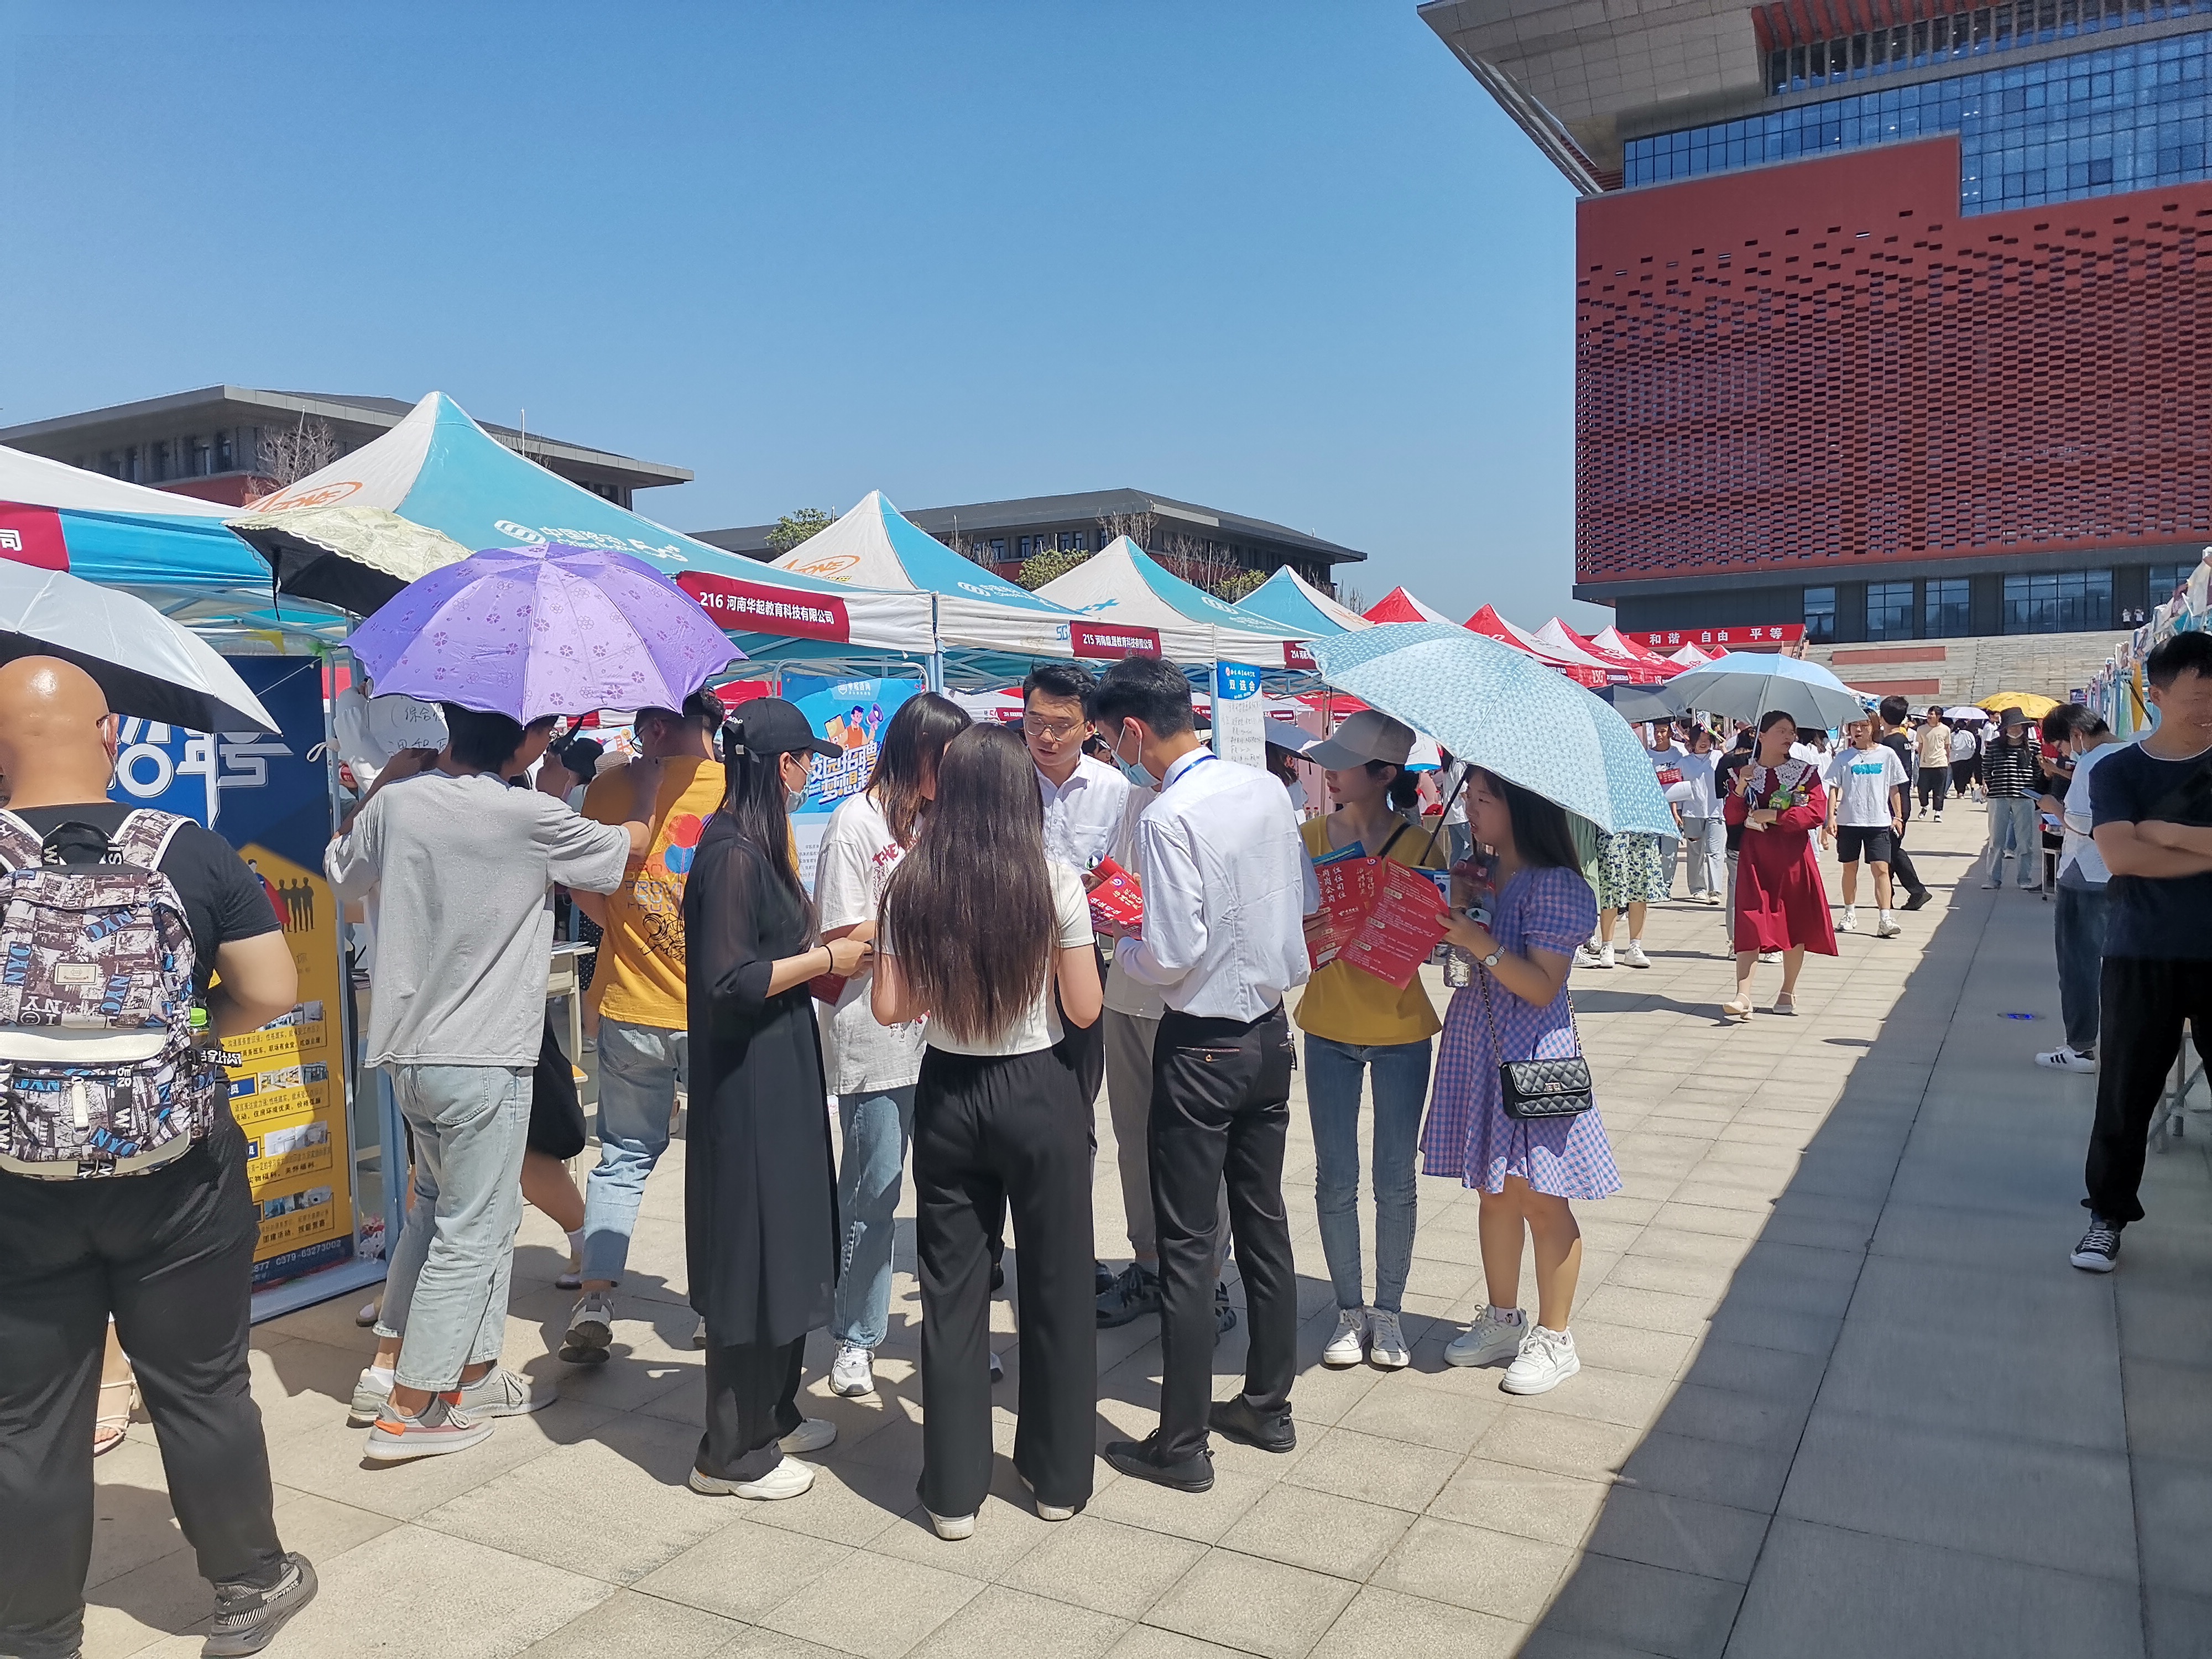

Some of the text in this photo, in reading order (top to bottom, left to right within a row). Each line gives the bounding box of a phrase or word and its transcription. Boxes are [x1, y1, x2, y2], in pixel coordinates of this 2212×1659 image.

[700, 592, 835, 625] 216 河南华起教育科技有限公司
[1082, 633, 1094, 645] 215
[1650, 627, 1783, 645] 和谐 自由 平等
[1229, 679, 1255, 692] 双选会
